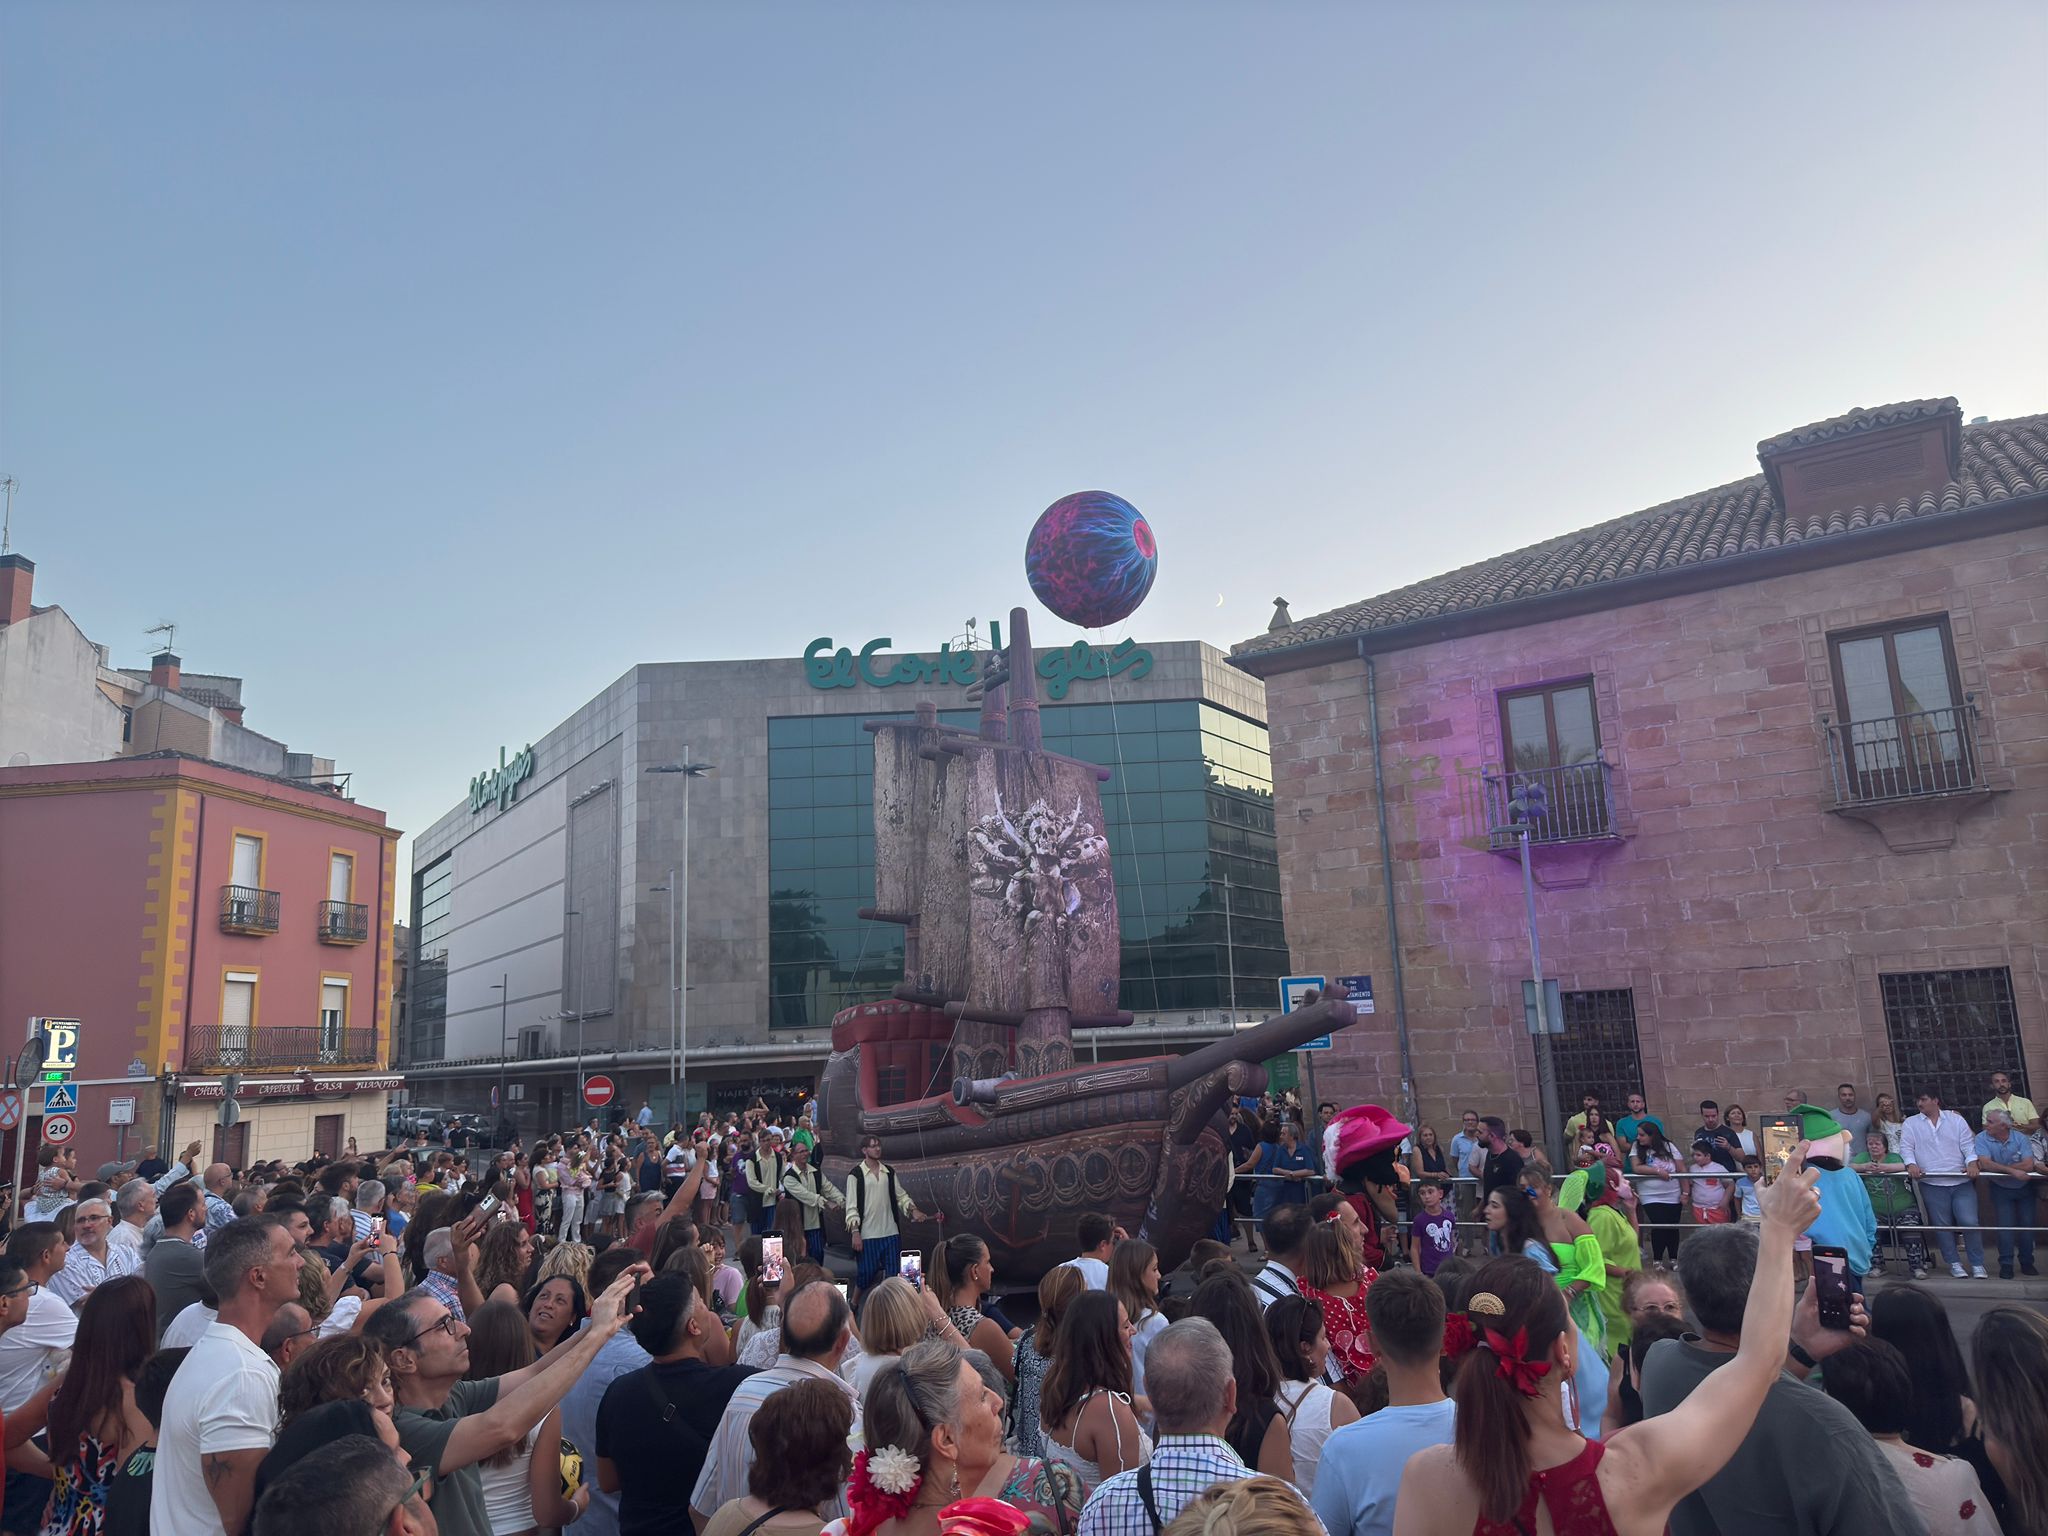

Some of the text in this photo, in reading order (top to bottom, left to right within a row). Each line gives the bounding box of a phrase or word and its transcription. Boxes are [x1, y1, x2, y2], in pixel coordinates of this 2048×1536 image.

[804, 637, 856, 689] El
[860, 638, 977, 686] Corte
[45, 1029, 76, 1063] P
[194, 1086, 244, 1097] CHURRIA
[315, 1082, 343, 1091] CASA
[355, 1080, 399, 1090] JUANITO
[717, 1087, 748, 1098] VIAJES
[49, 1124, 68, 1135] 20
